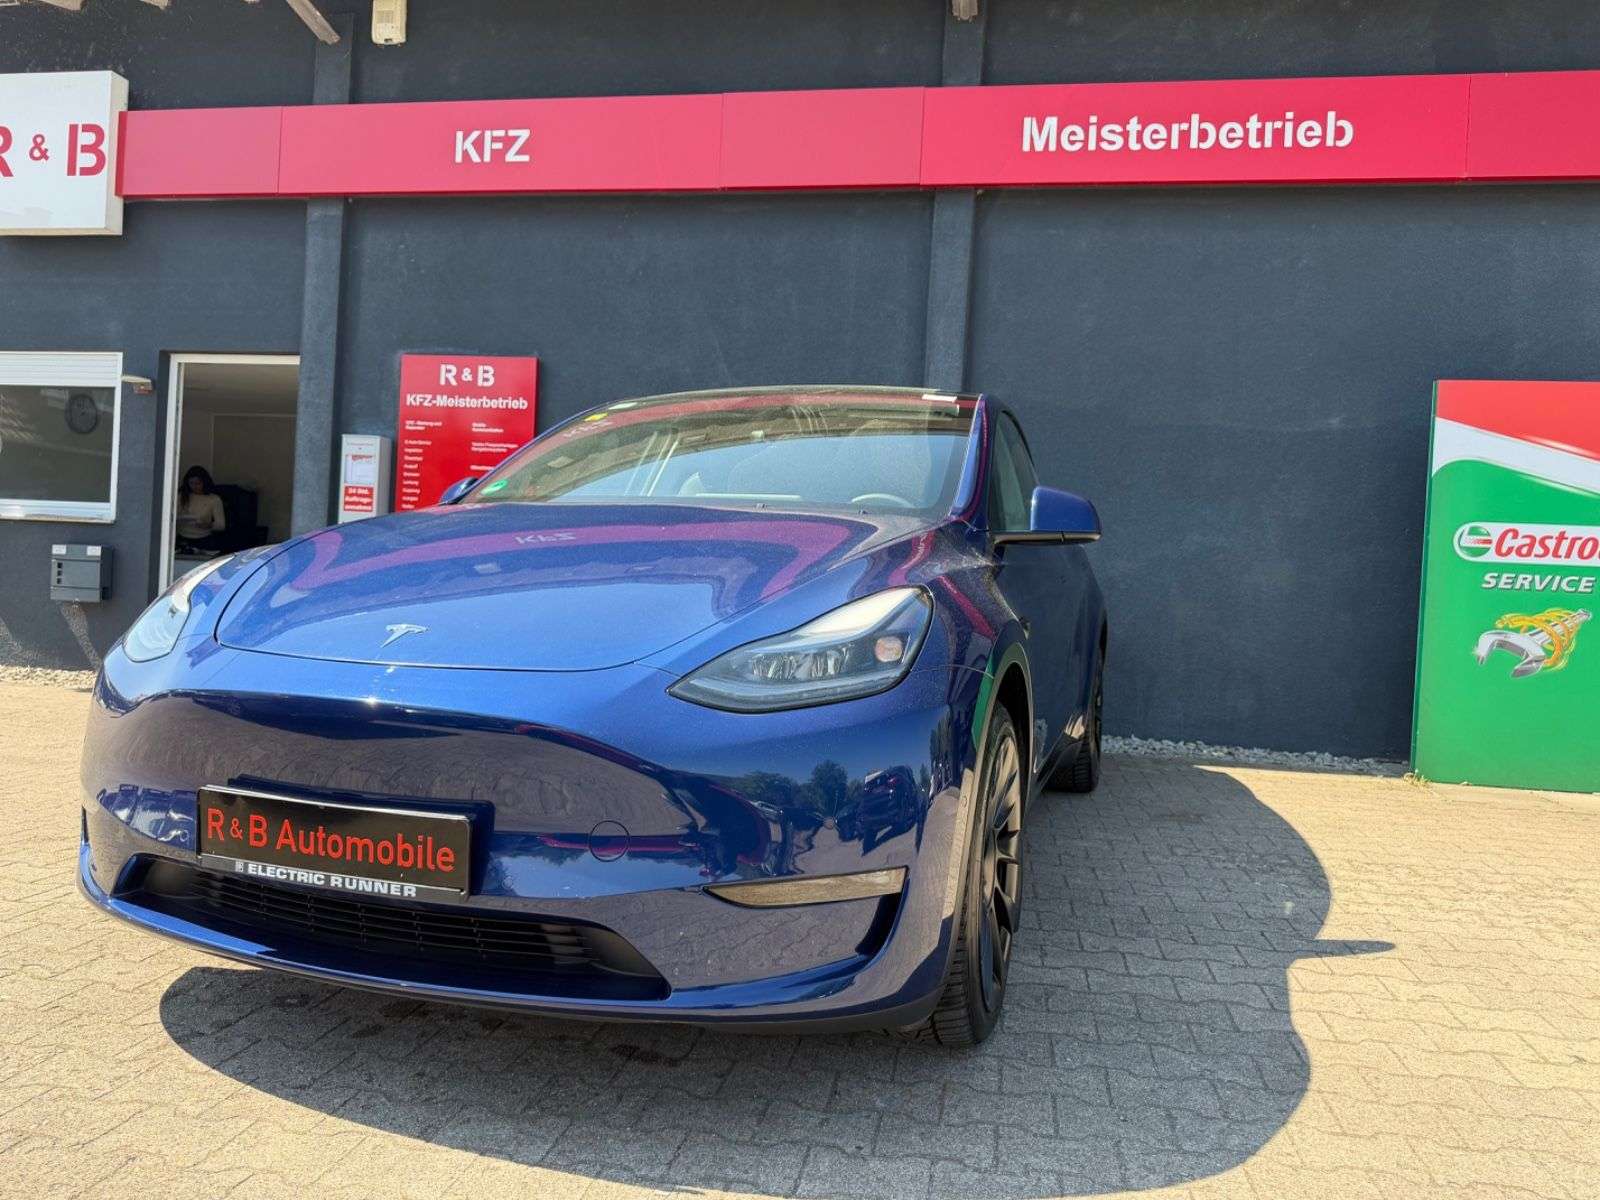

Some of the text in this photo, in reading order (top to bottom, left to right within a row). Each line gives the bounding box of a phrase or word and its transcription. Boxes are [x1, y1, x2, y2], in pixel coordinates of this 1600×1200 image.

[455, 129, 531, 163] KFZ
[1022, 111, 1354, 152] Meisterbetrieb
[29, 134, 50, 161] &
[67, 123, 106, 176] B
[440, 364, 495, 387] R & B
[406, 394, 529, 410] KFZ-Meisterbetrieb
[1494, 528, 1600, 560] Castro
[1481, 572, 1596, 594] SERVICE
[207, 808, 456, 873] R & B Automobile
[248, 863, 326, 887] ELECTRIC
[330, 876, 417, 898] RUNNER
